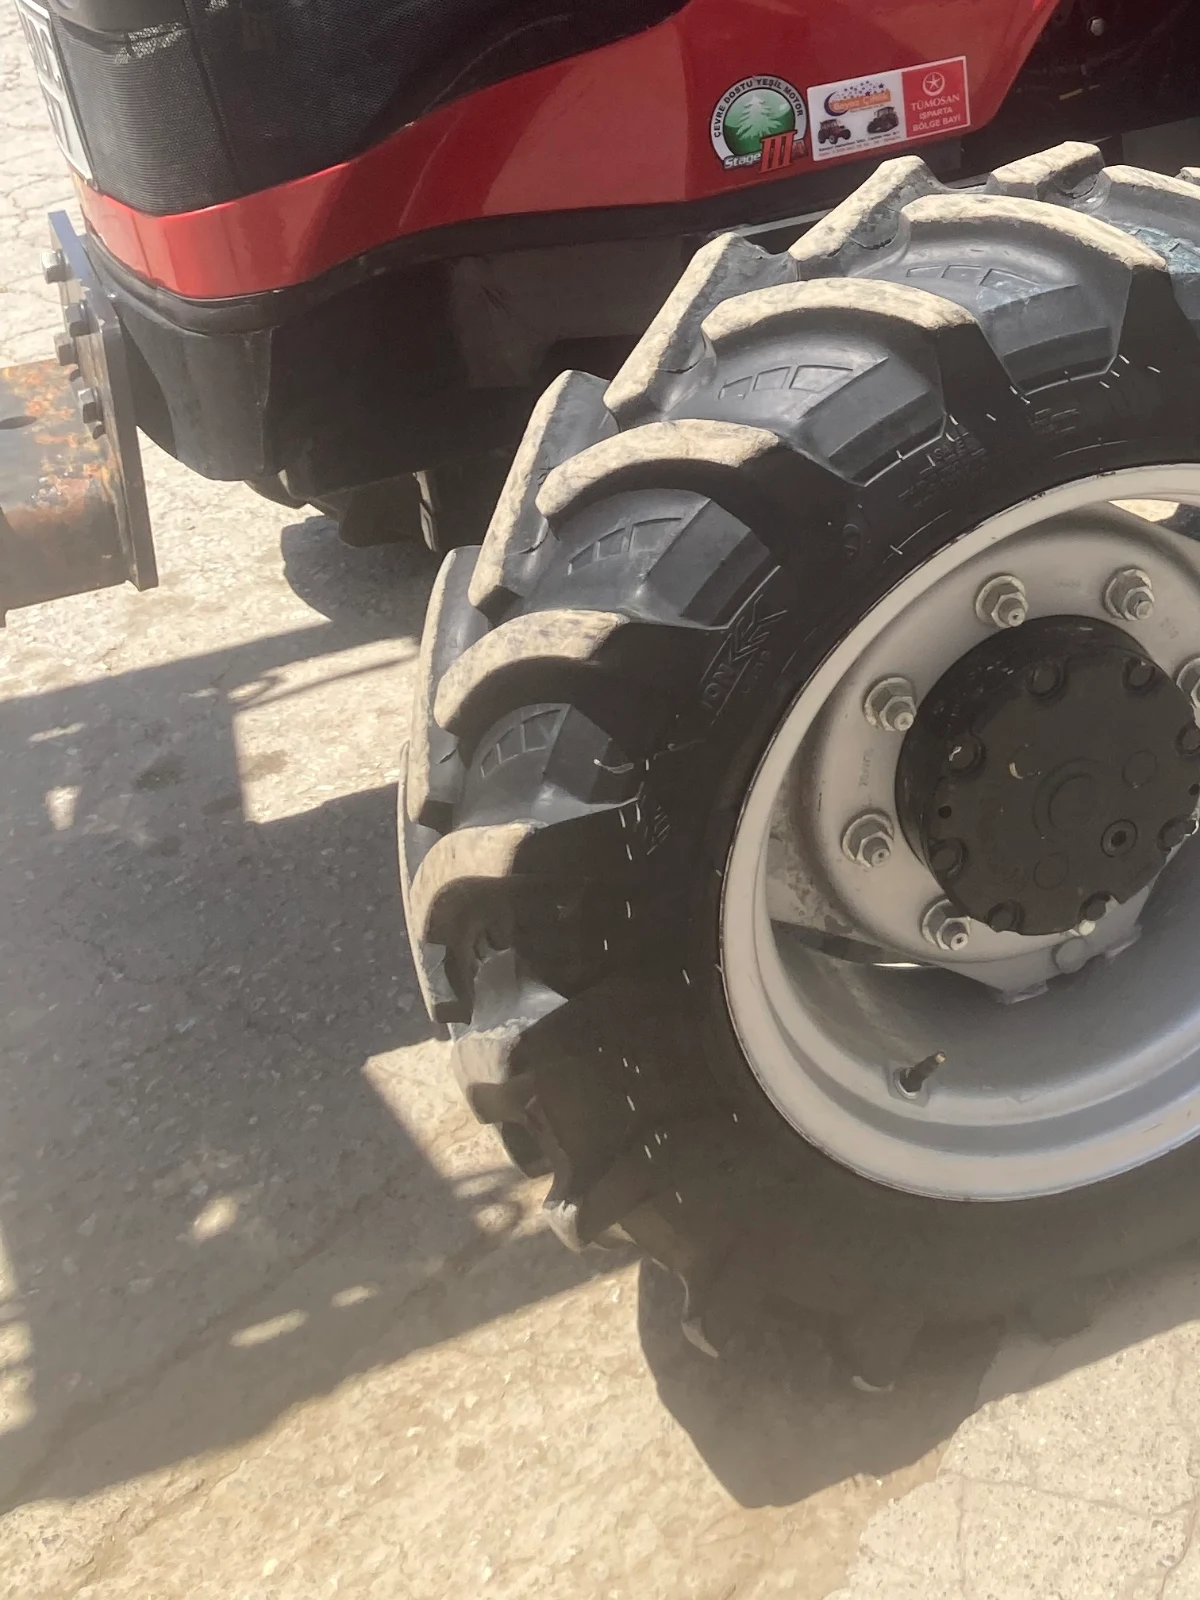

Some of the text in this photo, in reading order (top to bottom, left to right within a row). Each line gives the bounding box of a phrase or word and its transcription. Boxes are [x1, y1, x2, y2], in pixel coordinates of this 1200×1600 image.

[714, 77, 805, 138] ÇEVRE DOSTU YEŞİL MOTOR
[910, 93, 961, 111] TÜMOSAN
[912, 118, 942, 132] BÖLGE
[724, 153, 761, 170] Stage
